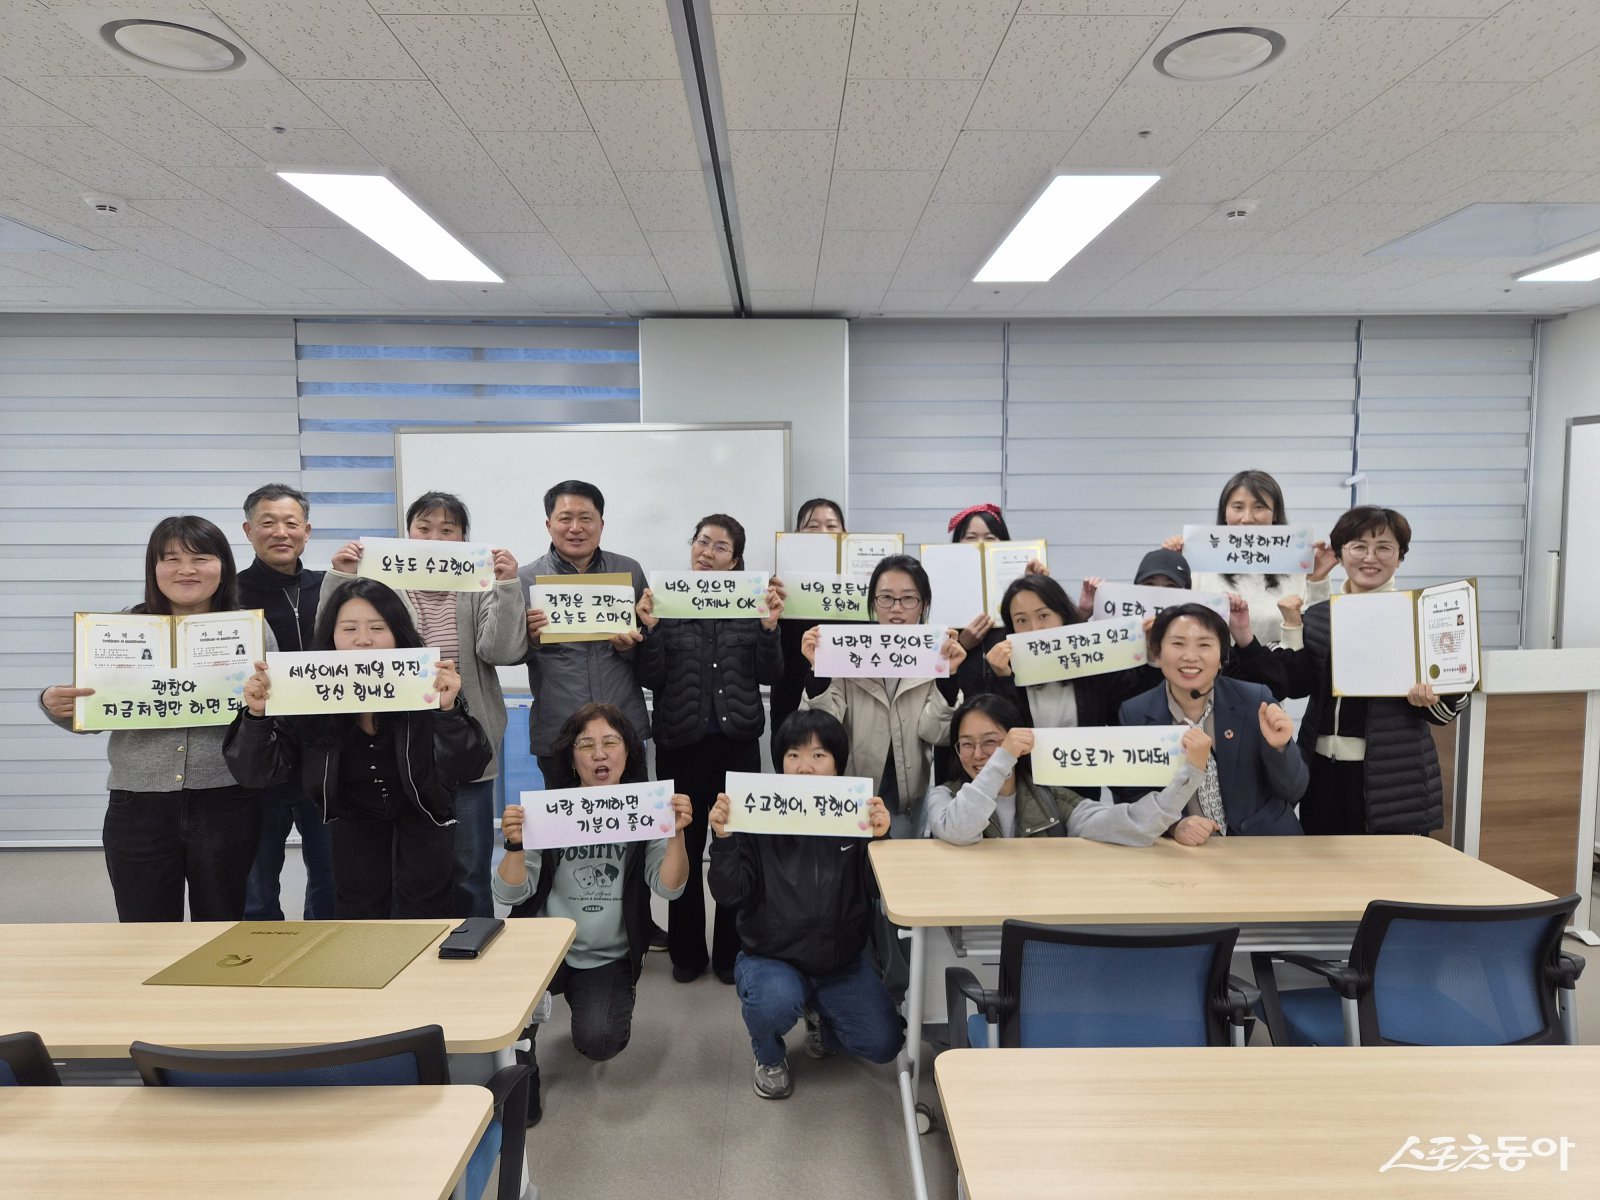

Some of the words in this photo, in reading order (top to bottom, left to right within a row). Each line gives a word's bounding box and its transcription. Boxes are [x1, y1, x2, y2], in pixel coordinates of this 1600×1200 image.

[1210, 534, 1220, 548] 늘
[1228, 534, 1290, 548] 행복하자!
[382, 554, 418, 574] 오늘도
[426, 556, 474, 576] 수고했어
[1226, 550, 1270, 564] 사랑해
[664, 580, 690, 594] 너와
[696, 578, 736, 594] 있으면
[800, 582, 824, 594] 너의
[546, 594, 584, 608] 걱정은
[692, 596, 730, 610] 언제나
[736, 598, 756, 608] OK
[822, 596, 860, 612] 응원해
[1104, 600, 1116, 616] 이
[550, 610, 586, 624] 오늘도
[596, 610, 632, 626] 스마일
[832, 634, 872, 648] 너라면
[880, 634, 934, 650] 무엇이든
[1026, 640, 1062, 656] 잘했고
[1066, 633, 1102, 650] 잘하고
[1106, 628, 1128, 644] 있고
[848, 652, 862, 668] 할
[870, 652, 882, 668] 수
[888, 652, 916, 668] 있어
[1058, 652, 1104, 670] 잘될거야
[290, 664, 348, 680] 세상에서
[354, 660, 384, 678] 제일
[392, 660, 420, 678] 멋진
[150, 678, 198, 696] 괜찮아
[316, 684, 344, 702] 당신
[352, 682, 396, 702] 힘내요
[102, 700, 182, 718] 지금처럼만
[188, 698, 220, 714] 하면
[227, 698, 242, 710] 돼
[1052, 748, 1114, 768] 앞으로가
[1122, 748, 1170, 766] 기대돼
[546, 800, 574, 816] 너랑
[580, 794, 638, 812] 함께하면
[744, 792, 806, 816] 수고했어,
[814, 794, 858, 817] 잘했어
[576, 816, 620, 834] 기분이
[626, 812, 654, 832] 좋아
